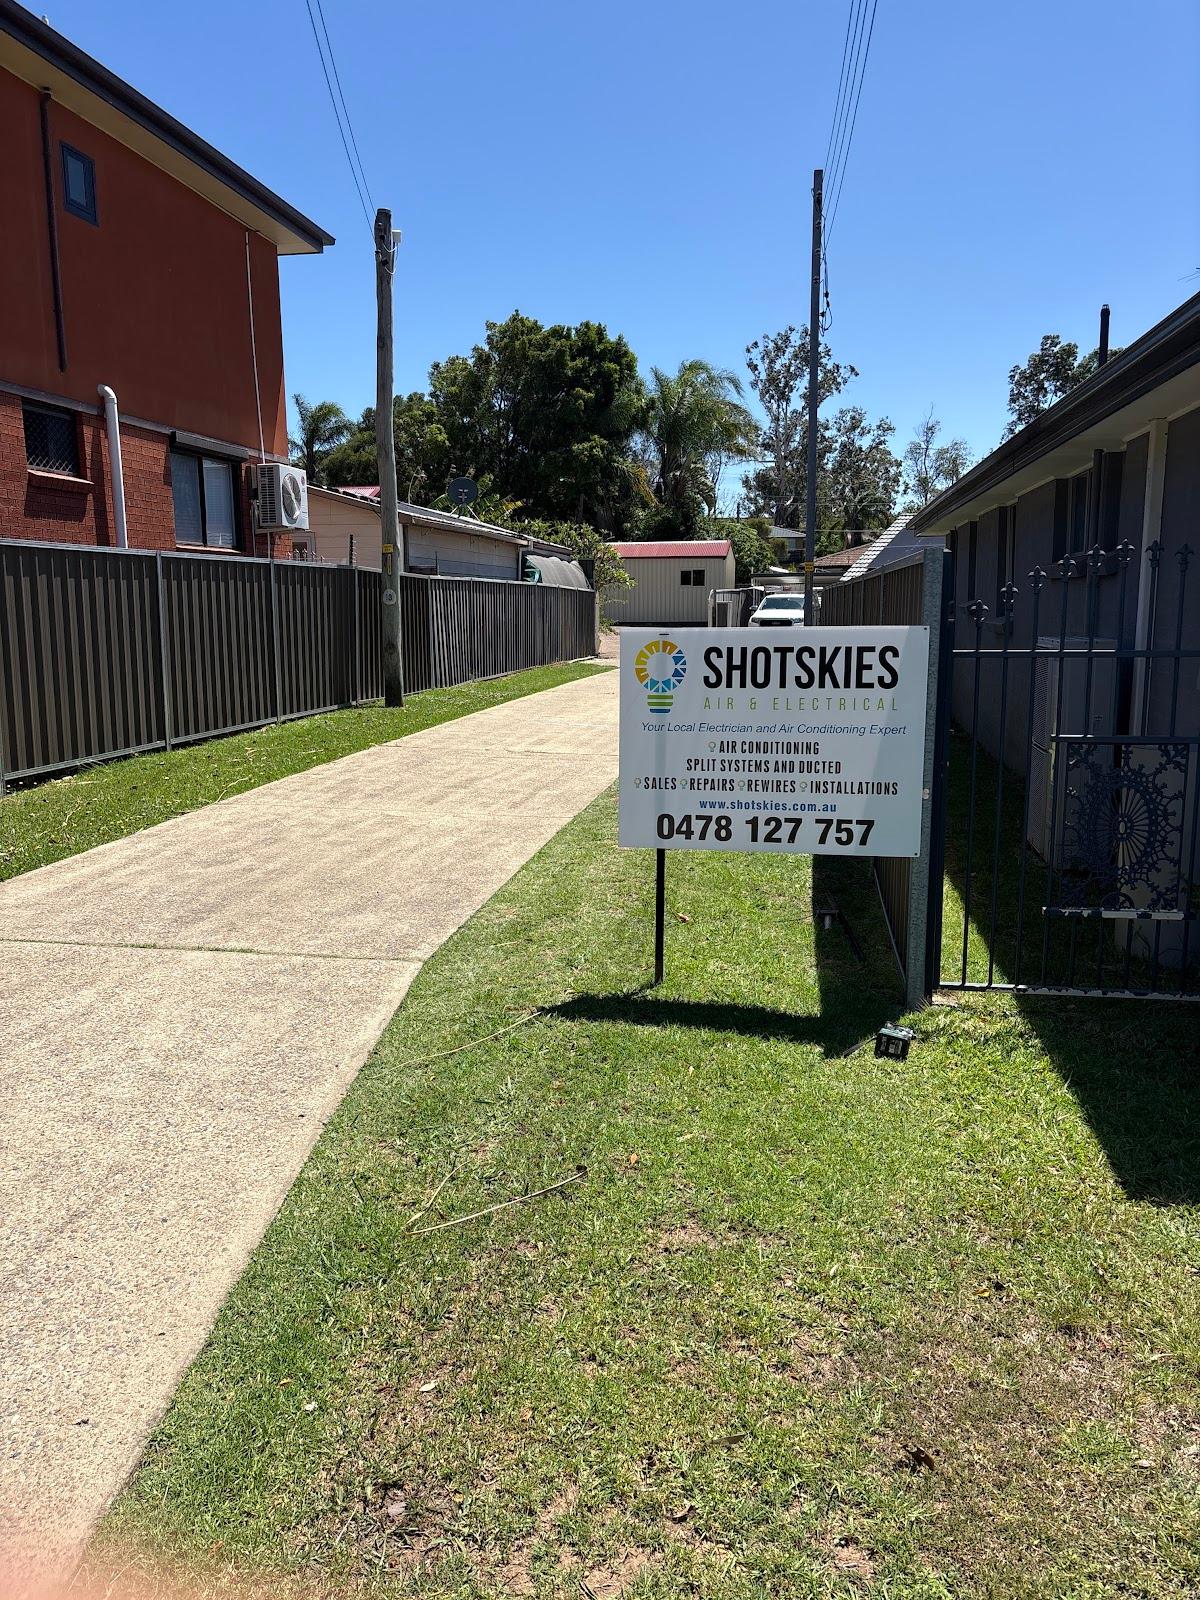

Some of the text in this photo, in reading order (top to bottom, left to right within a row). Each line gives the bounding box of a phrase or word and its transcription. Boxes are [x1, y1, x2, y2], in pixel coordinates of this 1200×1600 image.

[703, 645, 899, 689] SHOTSKIES
[704, 696, 898, 711] AIR & ELECTRICAL
[642, 721, 906, 737] Your Local Electrician and Air Conditioning Expert
[719, 740, 819, 755] AIR CONDITIONING
[686, 758, 841, 774] SPLIT SYSTEMS AND DUCTED
[644, 776, 898, 795] SALES REPAIRS REWIRES INSTALLATIONS
[699, 799, 836, 812] www.shotskies.com.au
[657, 813, 875, 846] 0478 127 757
